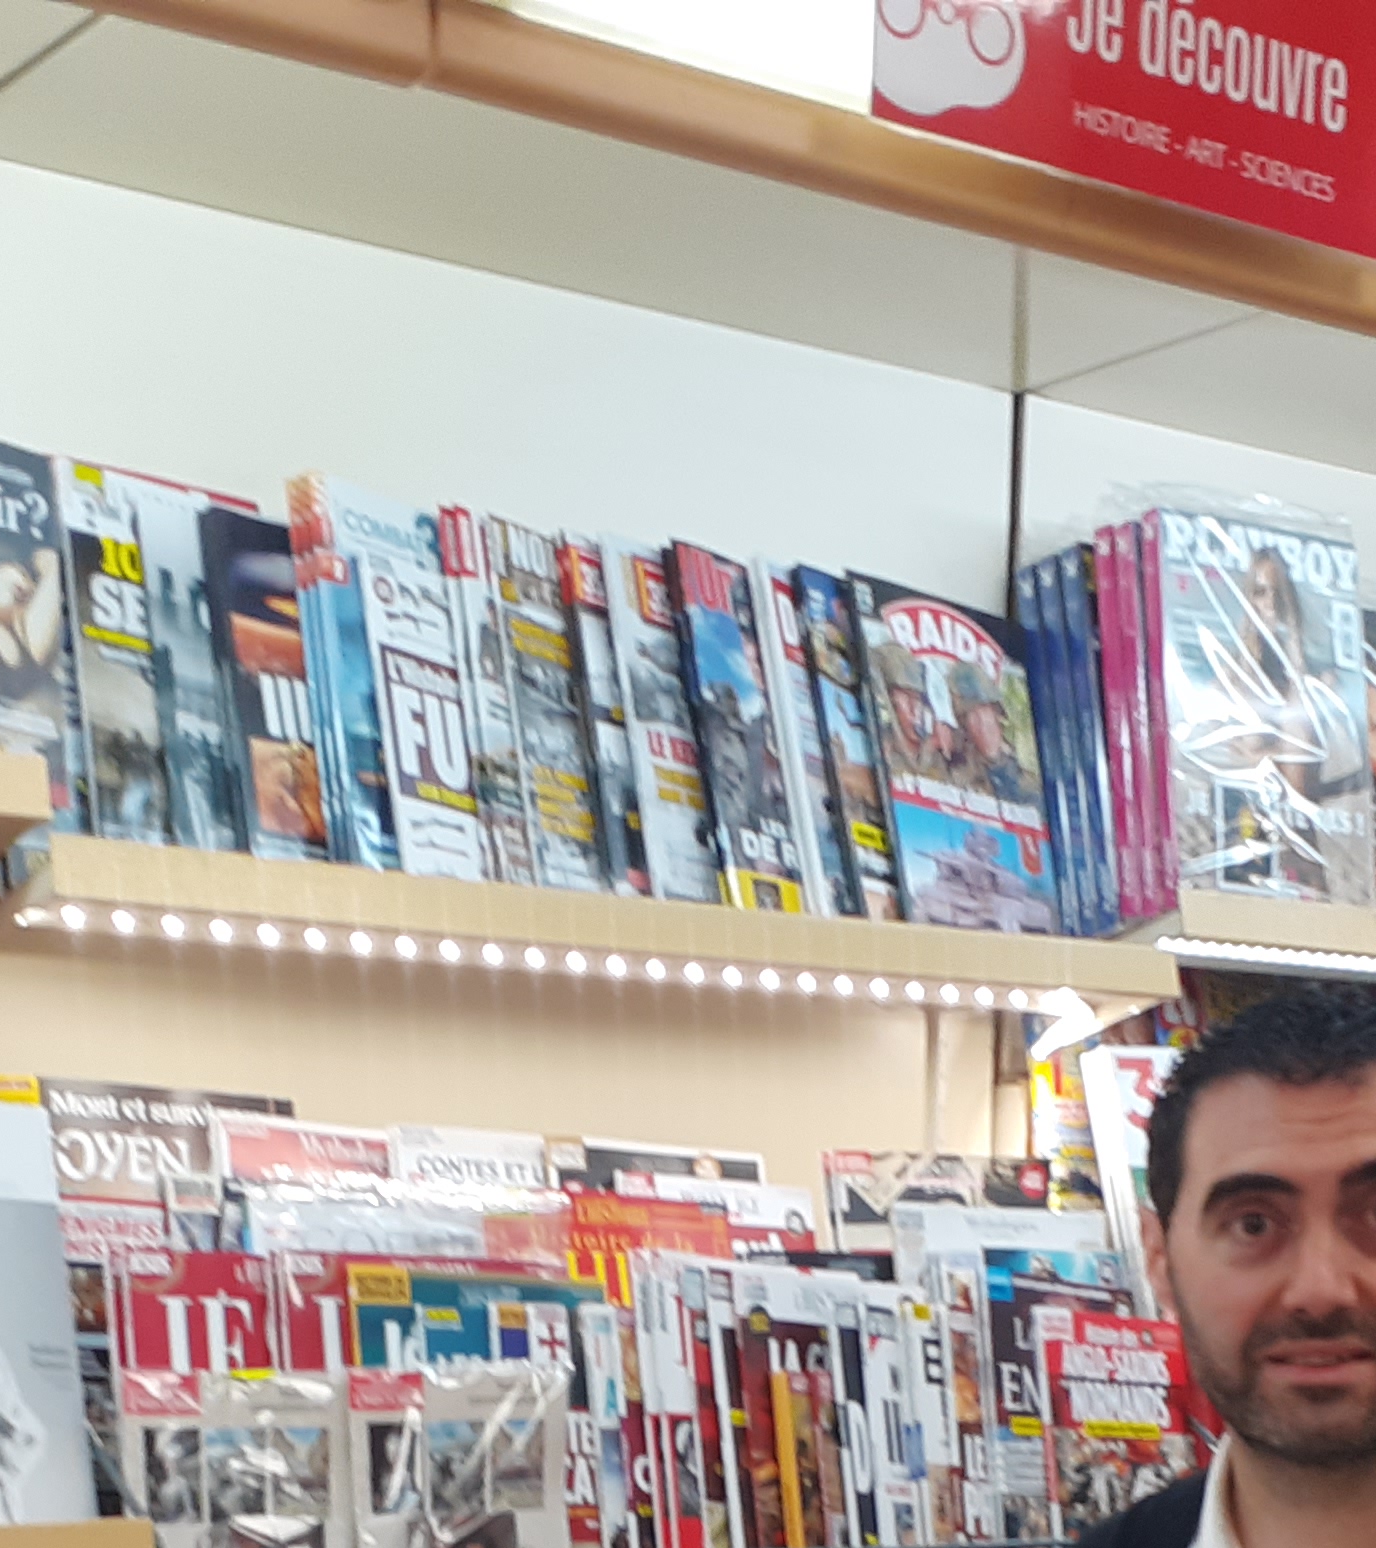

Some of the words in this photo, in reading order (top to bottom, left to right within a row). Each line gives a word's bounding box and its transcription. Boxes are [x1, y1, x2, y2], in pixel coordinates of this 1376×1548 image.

[1073, 102, 1171, 154] HISTOIRE
[1186, 136, 1227, 170] ART
[1240, 151, 1337, 203] SCIENCES
[888, 605, 1004, 684] RAIDS
